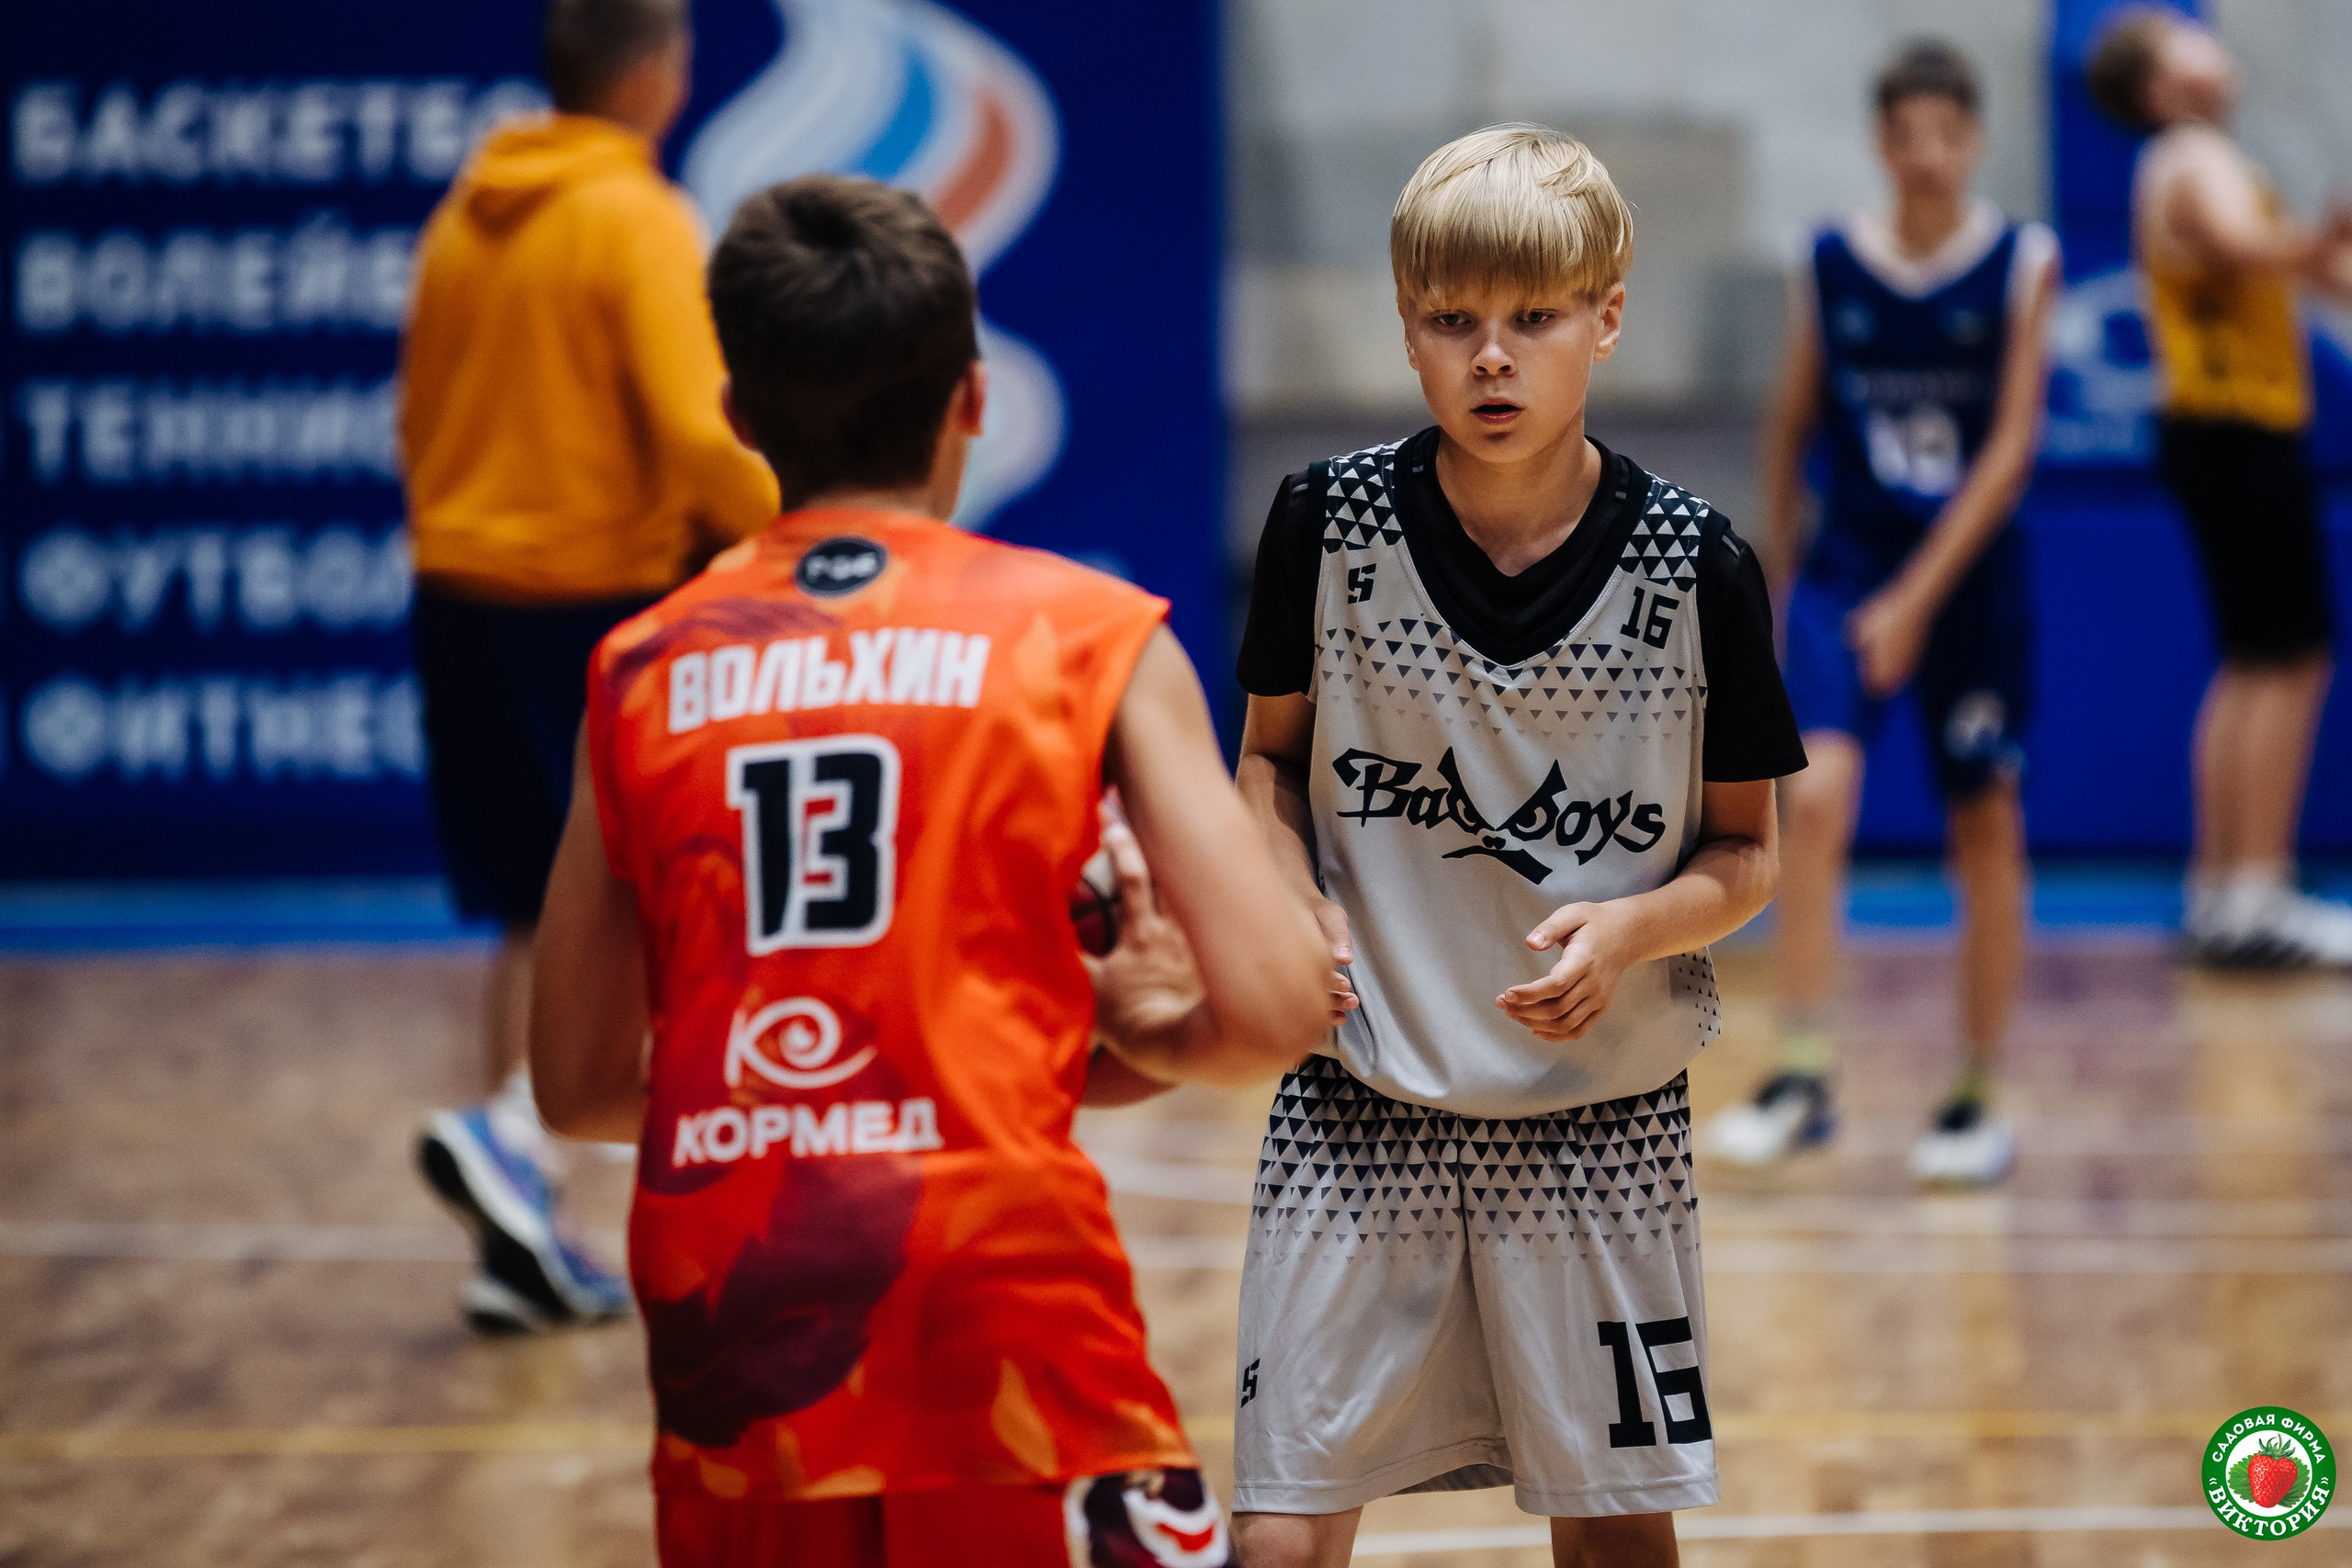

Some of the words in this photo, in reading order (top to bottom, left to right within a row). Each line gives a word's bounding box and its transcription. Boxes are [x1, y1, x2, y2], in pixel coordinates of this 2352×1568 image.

[1620, 586, 1680, 649] 16
[669, 627, 990, 734] ВОЛЬХИН
[726, 734, 901, 956] 13
[1332, 747, 1493, 837] Bad
[1499, 759, 1666, 865] boys
[673, 1097, 945, 1168] КОРМЕД
[1597, 1316, 1713, 1449] 16
